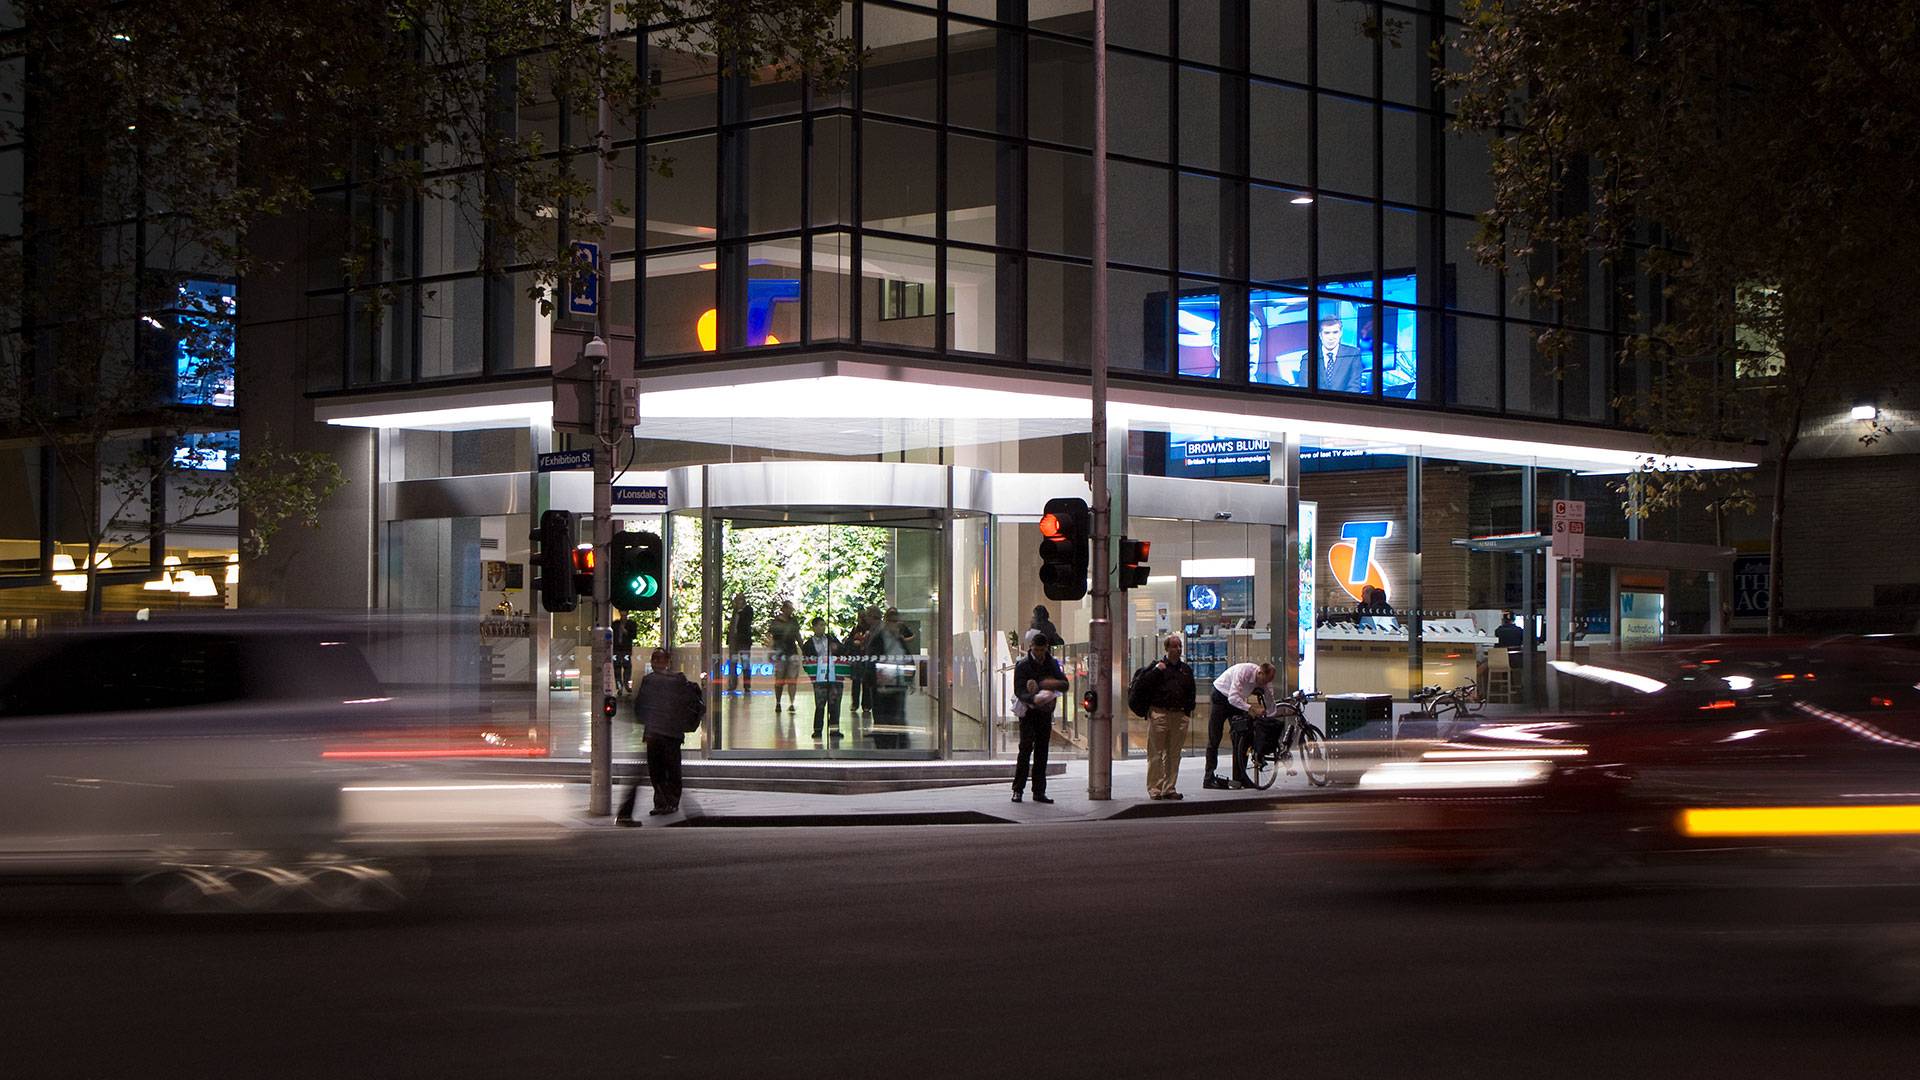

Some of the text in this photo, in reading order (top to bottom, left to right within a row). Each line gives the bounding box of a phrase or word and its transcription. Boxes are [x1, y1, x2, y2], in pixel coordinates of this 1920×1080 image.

[1188, 439, 1270, 454] BROWN'S BLUND
[545, 454, 581, 466] Exhibition
[582, 452, 591, 462] St
[623, 489, 667, 500] Lonsdale St
[1340, 520, 1394, 585] T
[1735, 574, 1770, 590] TH
[1736, 590, 1770, 610] AG
